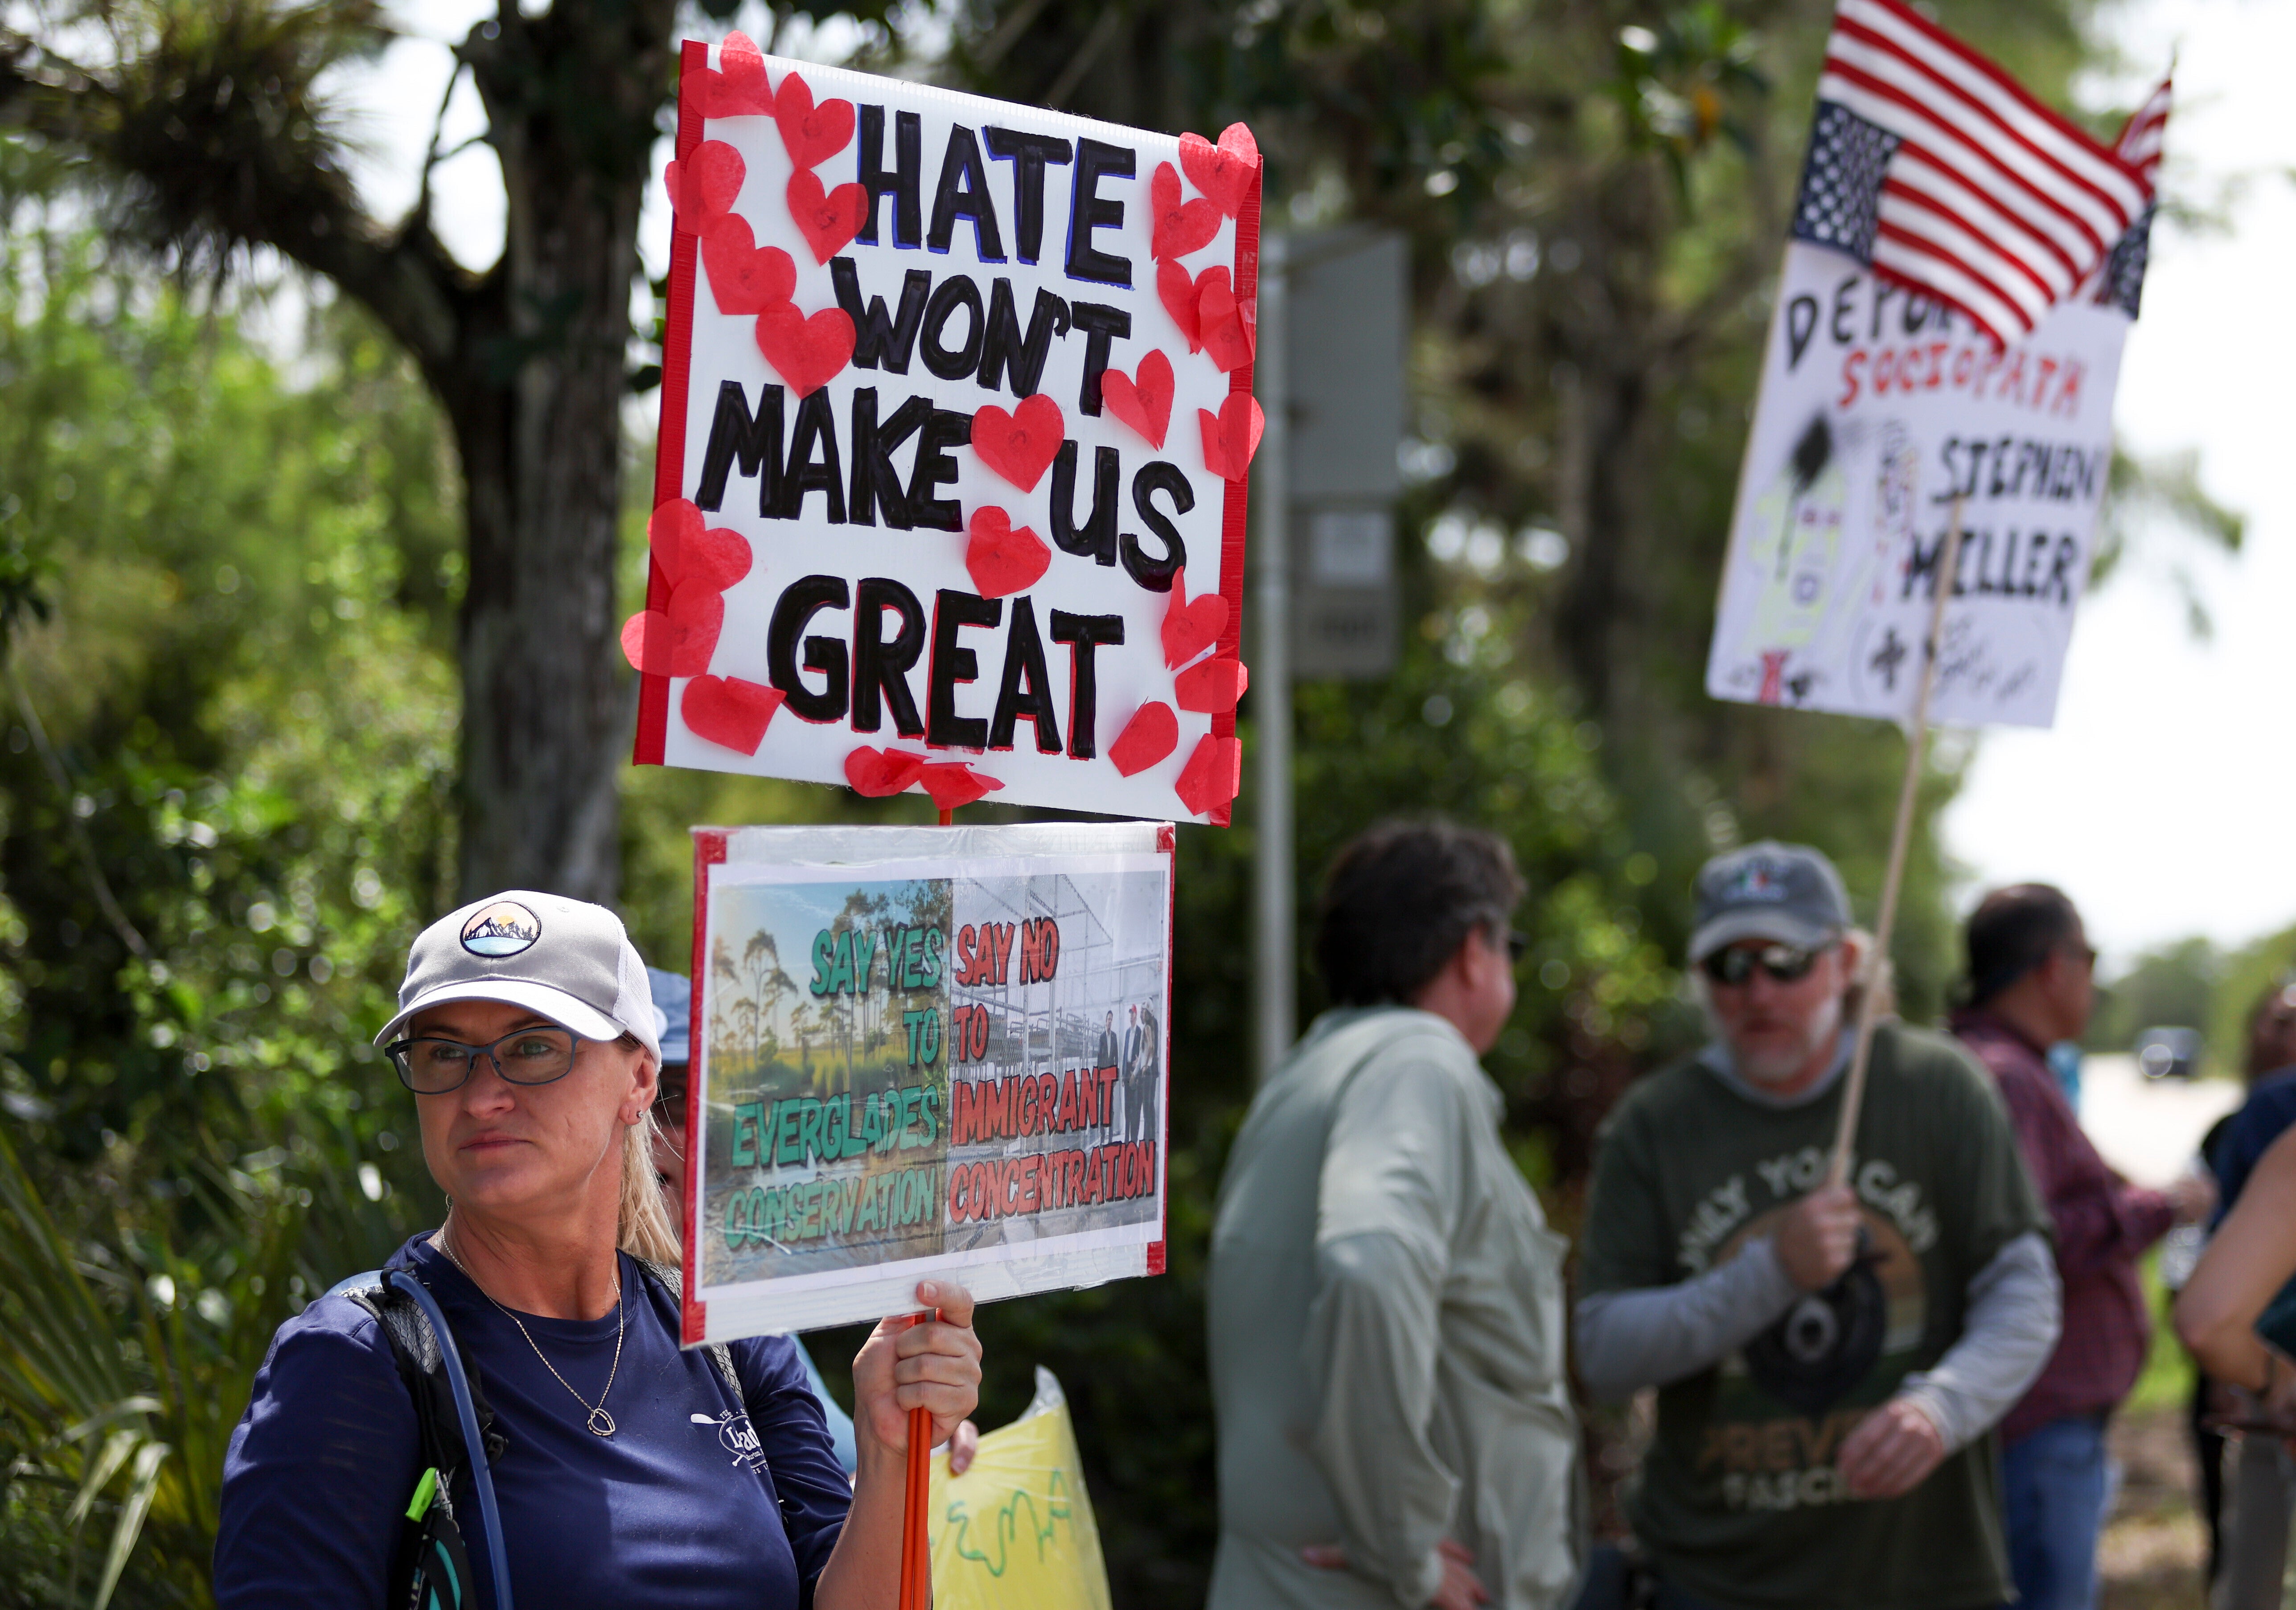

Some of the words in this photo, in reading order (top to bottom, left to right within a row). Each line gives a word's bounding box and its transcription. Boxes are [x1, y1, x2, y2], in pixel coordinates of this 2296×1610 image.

[856, 102, 1137, 289] HATE
[830, 256, 1131, 417] WON'T
[694, 380, 973, 533] MAKE
[1049, 439, 1195, 593] US
[1930, 433, 2096, 506] STEPHEN
[1901, 529, 2078, 606] MILLER
[767, 574, 1124, 761] GREAT
[809, 928, 876, 998] SAY
[884, 922, 944, 990] YES
[954, 921, 1016, 987] SAY
[1019, 916, 1060, 983] NO
[903, 1007, 940, 1068] TO
[953, 1003, 990, 1063] TO
[731, 1083, 939, 1169] EVERGLADES
[950, 1064, 1118, 1147] IMMIGRANT
[723, 1167, 936, 1249] CONSERVATION
[948, 1141, 1156, 1225] CONCENTRATION
